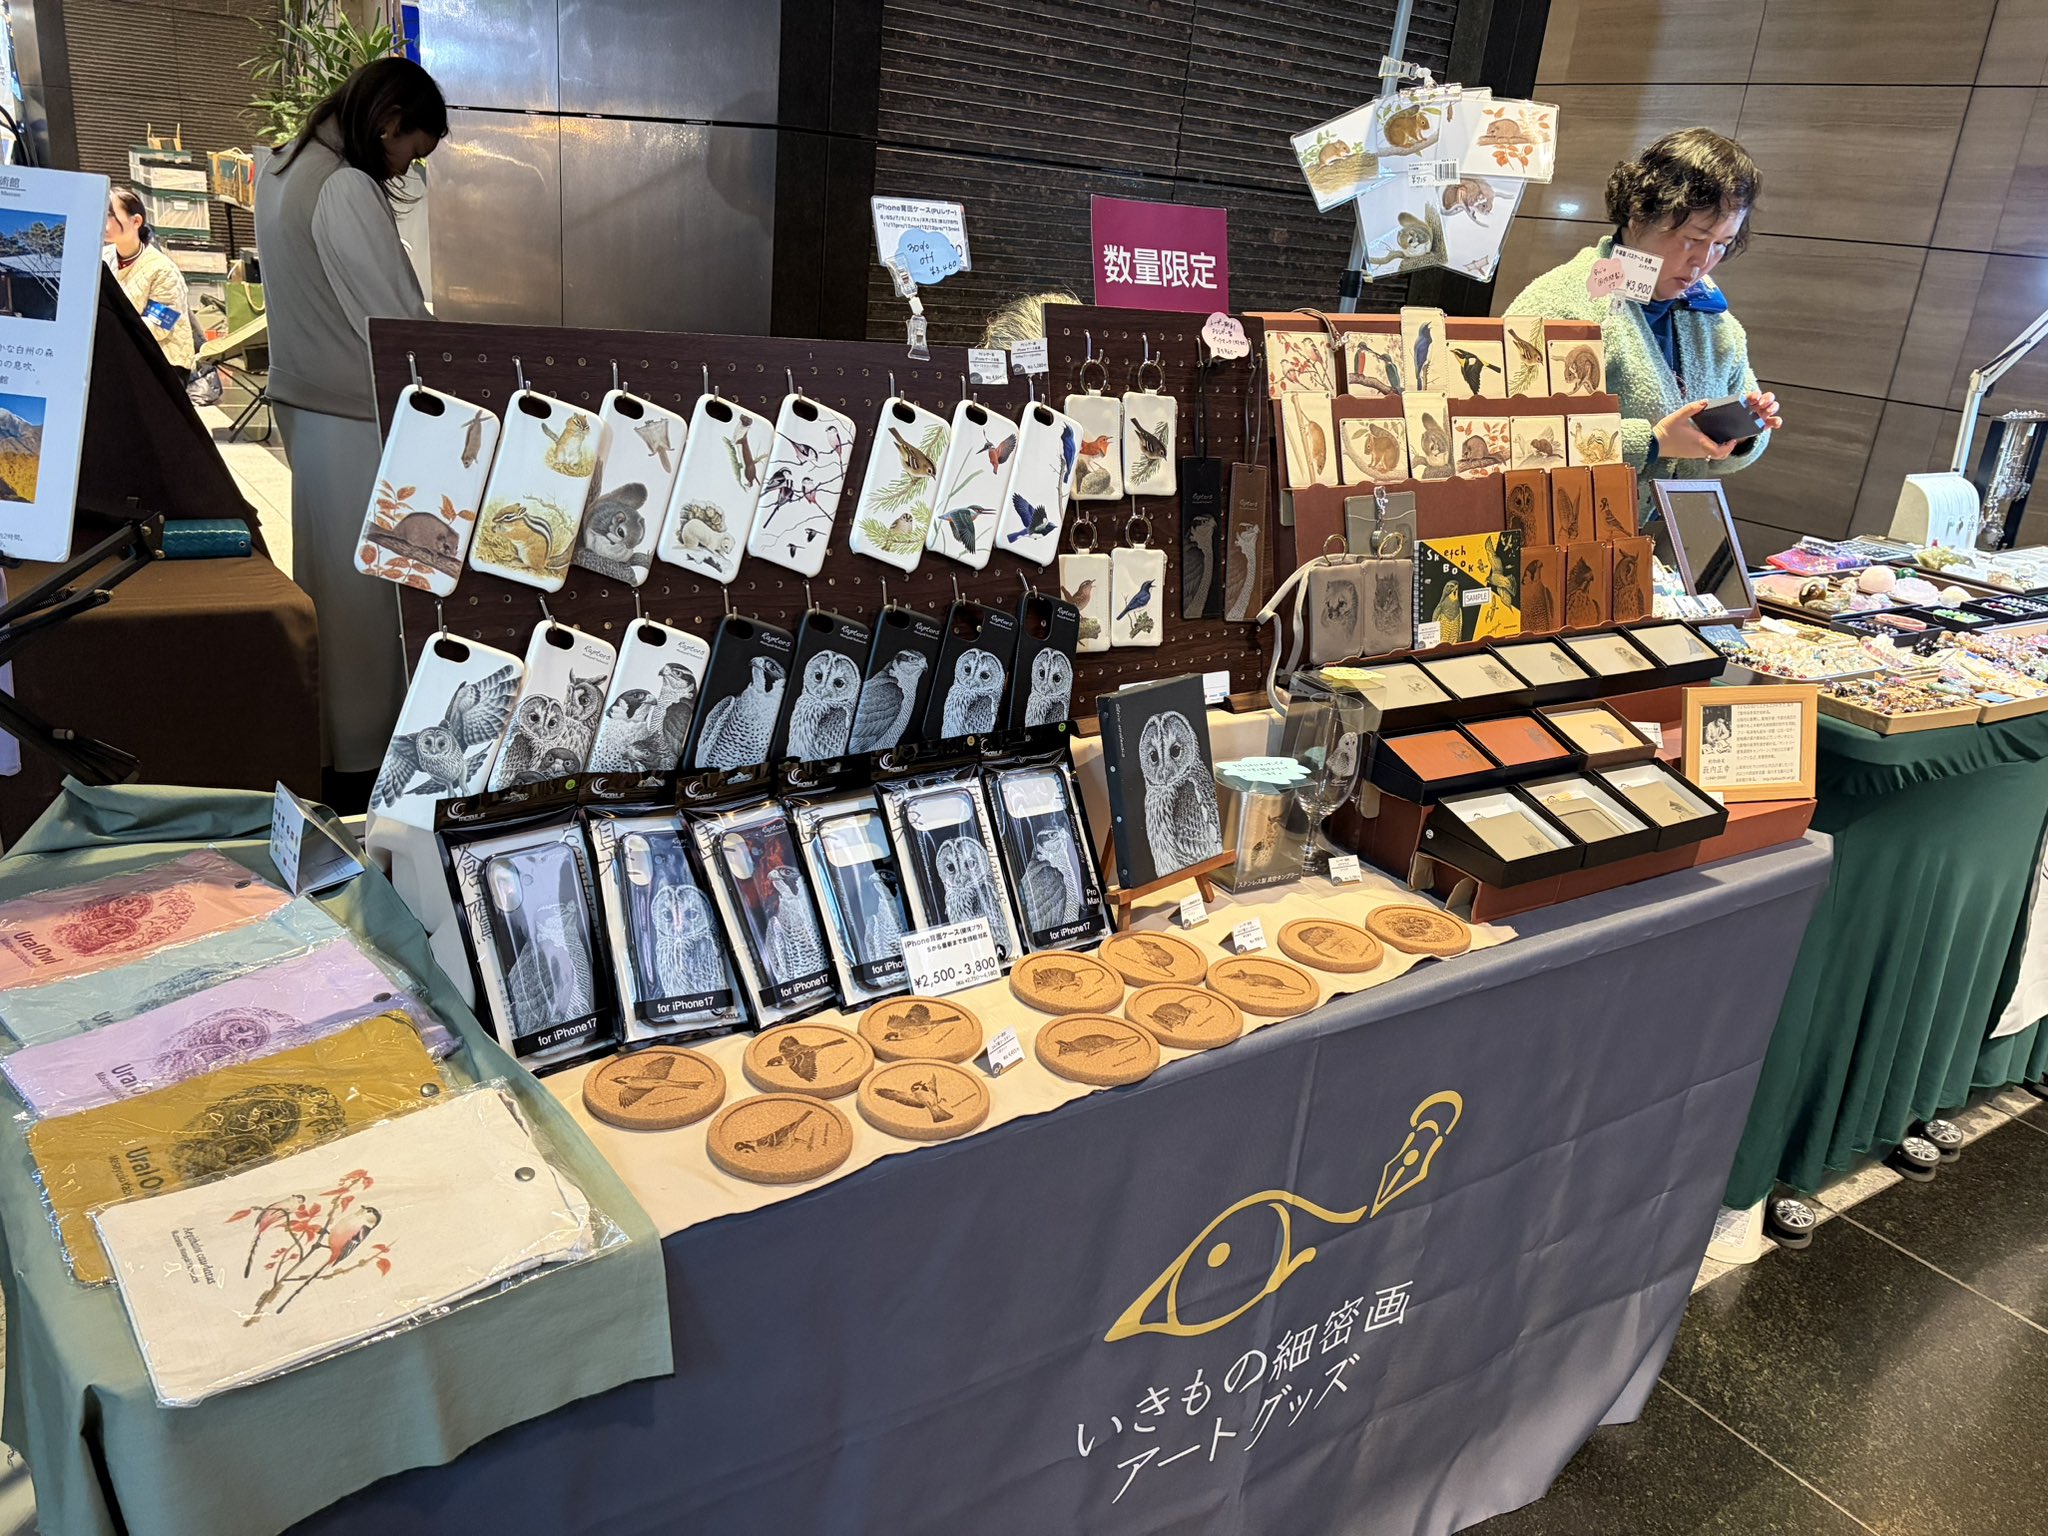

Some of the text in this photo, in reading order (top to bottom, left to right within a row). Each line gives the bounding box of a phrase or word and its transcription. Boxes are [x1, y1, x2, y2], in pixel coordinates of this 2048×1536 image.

[1103, 244, 1218, 289] 数量限定
[1625, 279, 1653, 296] ¥3,900
[1466, 592, 1488, 603] SAMPLE
[914, 621, 940, 636] Raptors
[990, 614, 1014, 628] Raptors
[760, 631, 791, 647] Raptors
[840, 624, 869, 640] Raptors
[584, 645, 612, 661] Raptors
[678, 641, 705, 656] Raptors
[1086, 888, 1097, 897] Pro
[1086, 897, 1100, 906] Max
[1050, 921, 1091, 941] for iPhone17
[13, 930, 46, 951] Ural
[31, 947, 64, 966] Owl
[872, 959, 905, 975] for iPho
[913, 966, 956, 989] ¥2,500
[964, 956, 996, 976] 3,800
[780, 973, 829, 998] for iPhone17
[657, 996, 715, 1014] for iPhone17
[537, 1017, 598, 1047] for iPhone17
[125, 1145, 161, 1177] Ural
[1077, 1281, 1413, 1457] いきもの細密画
[1111, 1353, 1361, 1504] アートグッズ
